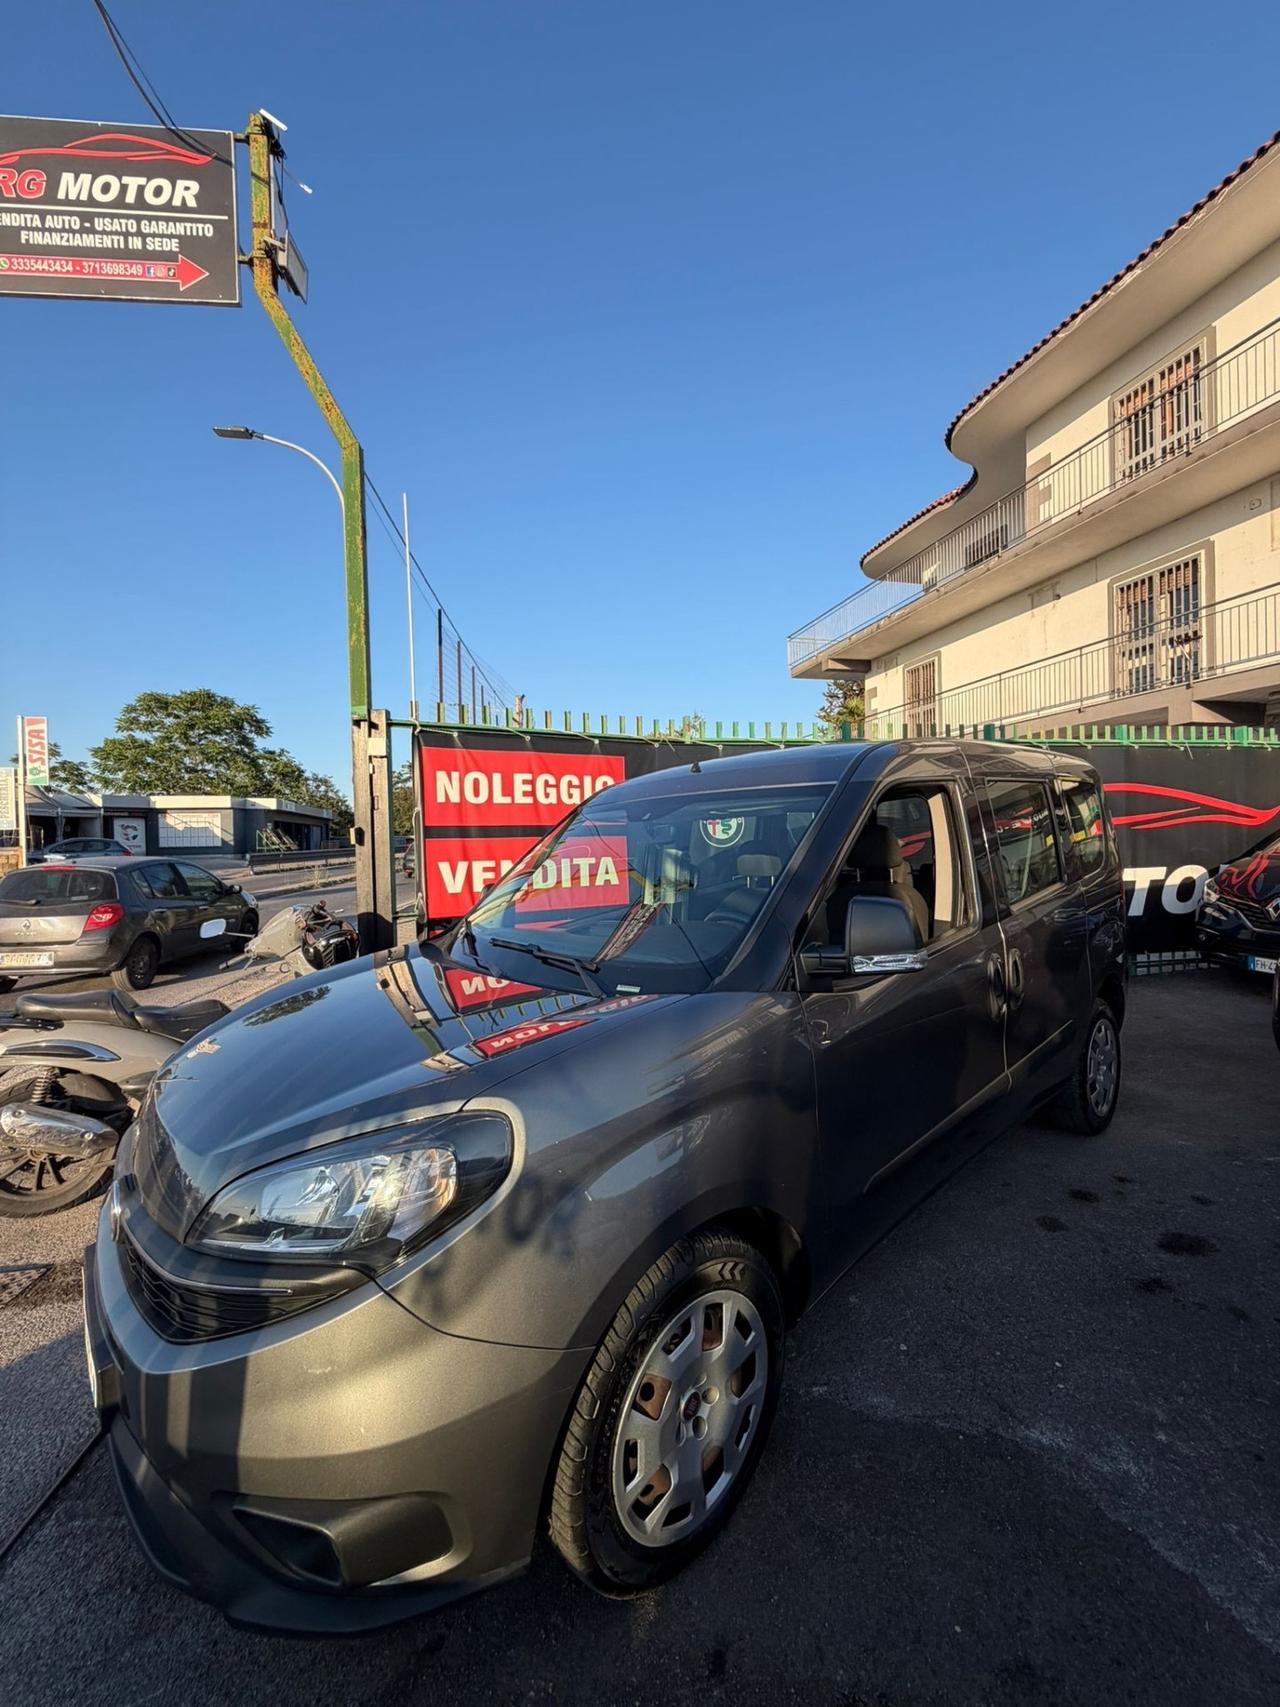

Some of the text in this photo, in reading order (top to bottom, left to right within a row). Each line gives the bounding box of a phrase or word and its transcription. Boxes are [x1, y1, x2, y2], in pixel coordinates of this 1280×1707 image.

[0, 168, 200, 207] RG MOTOR
[20, 230, 180, 251] FINANZIAMENTI IN SEDE
[45, 215, 81, 230] AUTO
[94, 217, 137, 232] USATO
[140, 220, 214, 237] GARANTITO
[11, 258, 73, 273] 3335443434
[28, 729, 46, 766] SISA
[1122, 864, 1222, 917] TO
